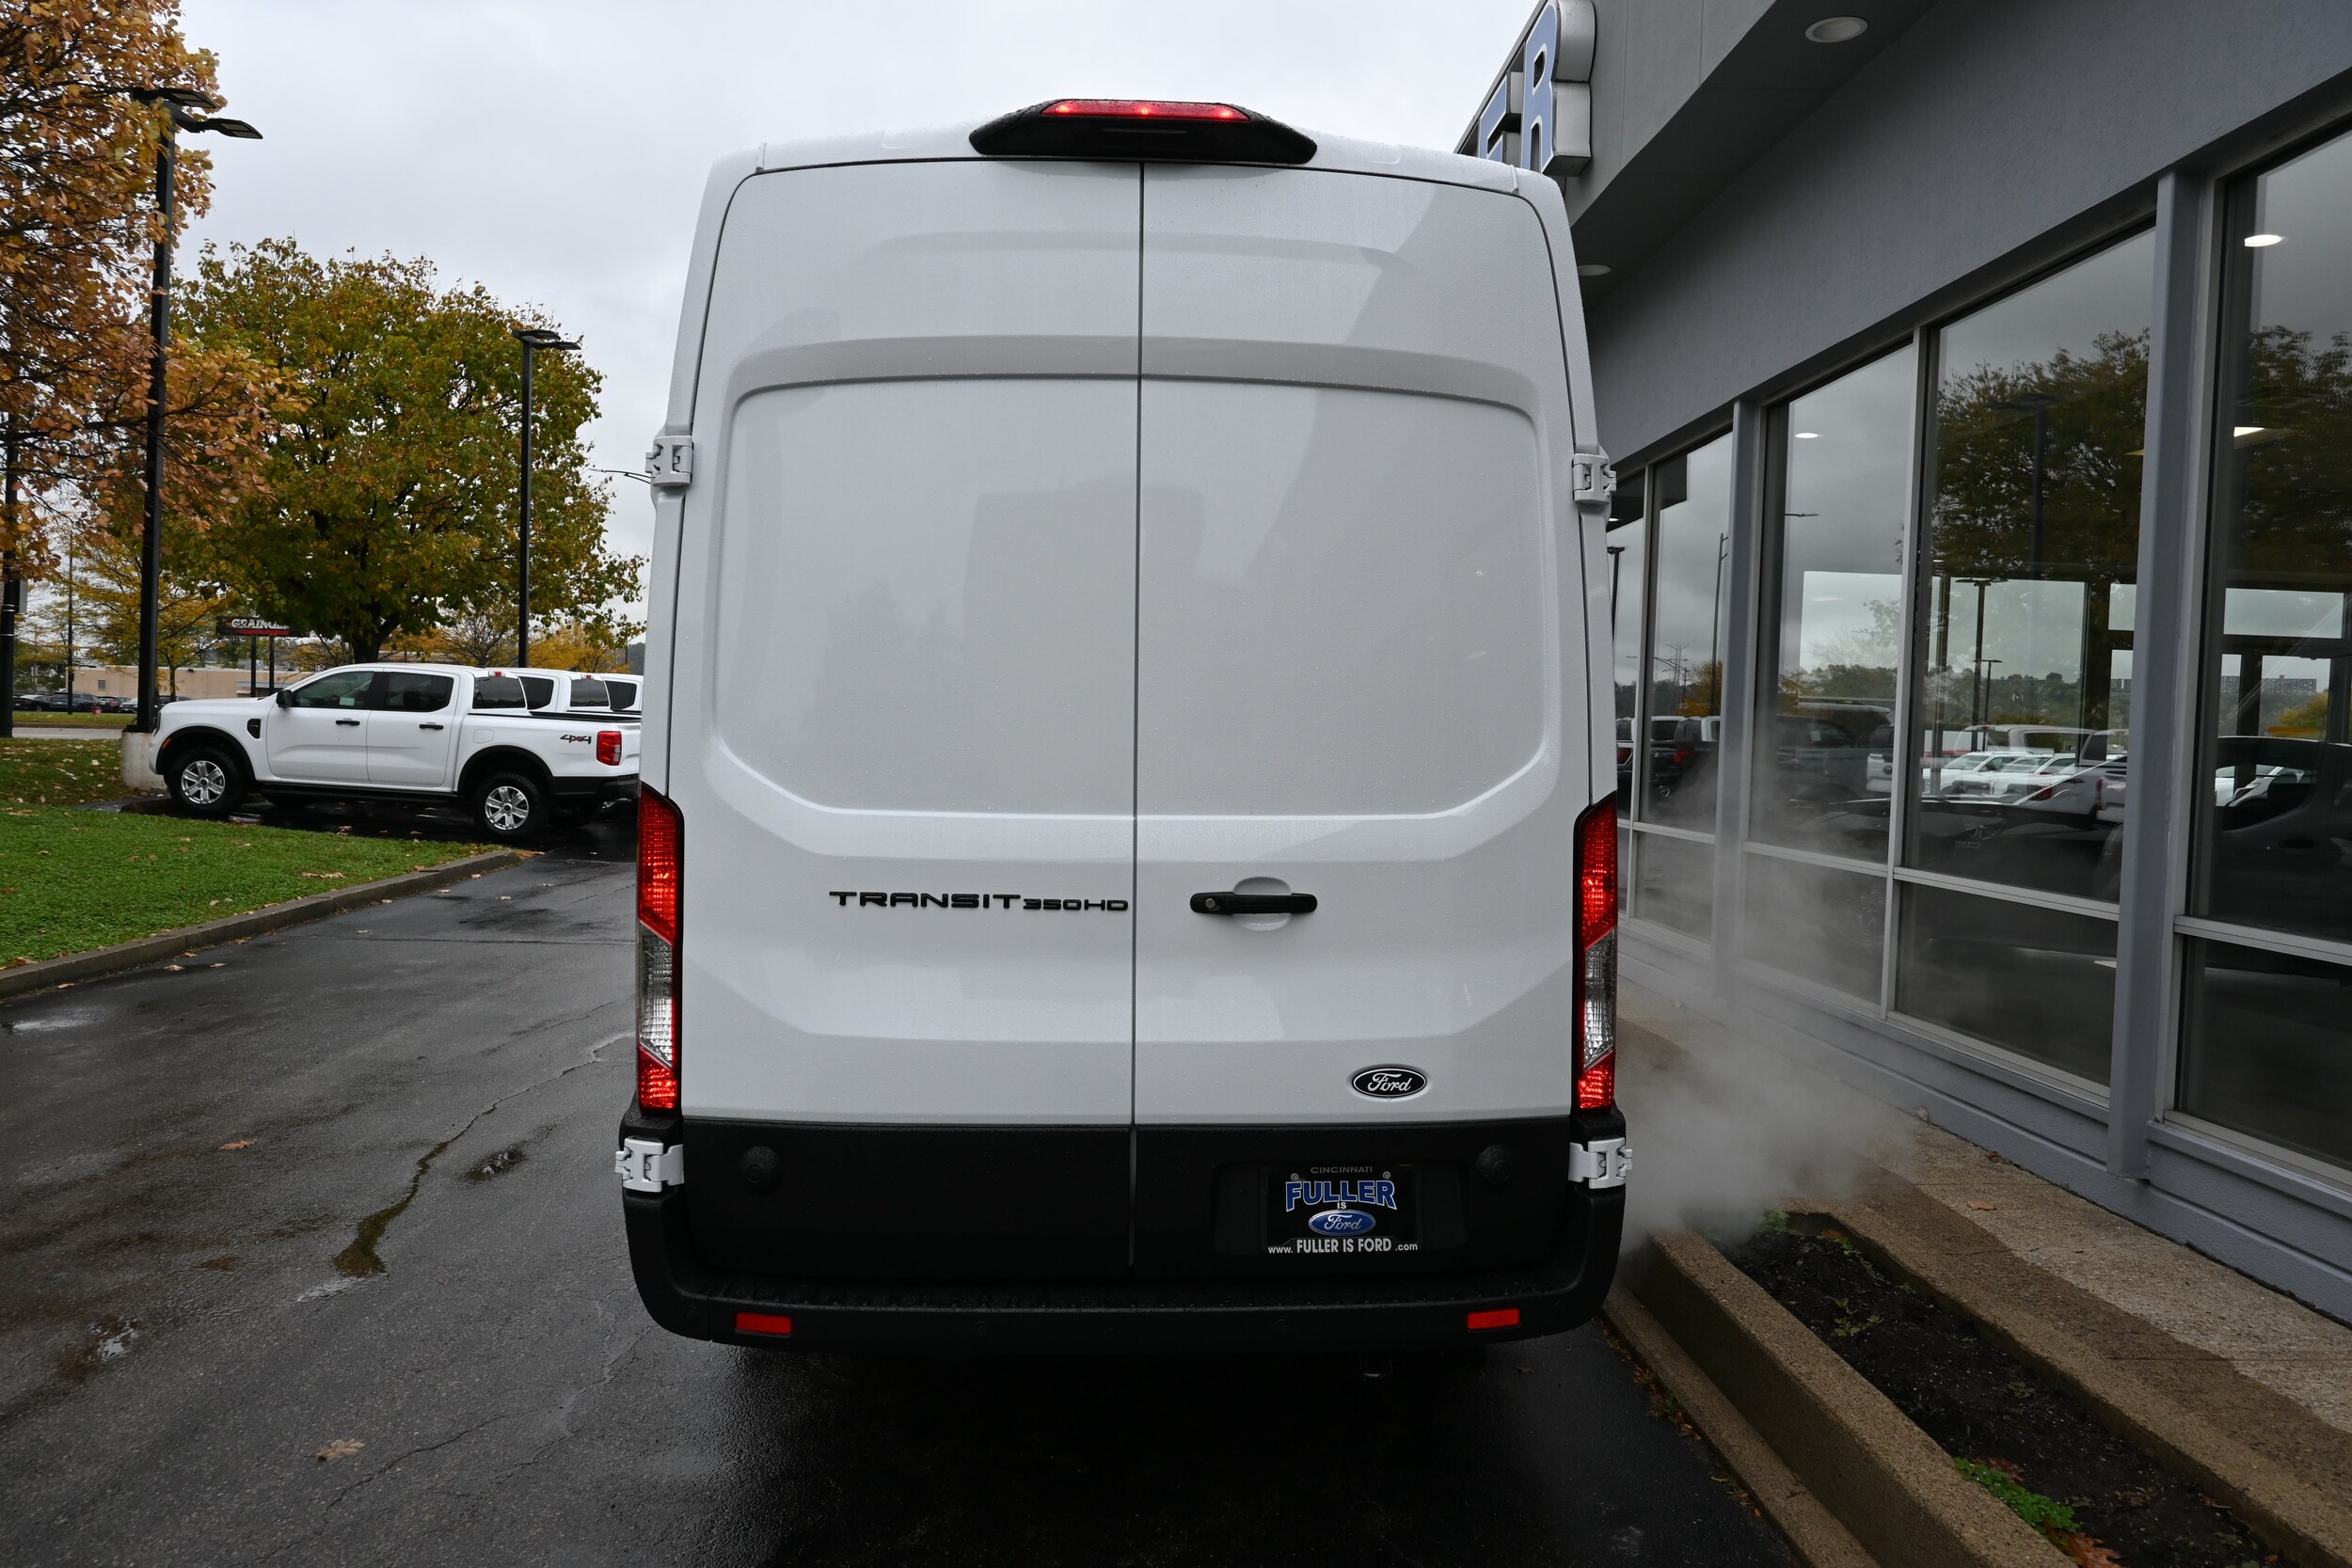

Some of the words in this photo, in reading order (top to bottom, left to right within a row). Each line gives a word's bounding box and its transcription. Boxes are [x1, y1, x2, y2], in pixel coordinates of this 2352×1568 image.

[829, 891, 1021, 909] TRANSIT
[1023, 898, 1128, 911] 350HD
[1367, 1072, 1412, 1092] Ford
[1311, 1165, 1373, 1174] CINCINNATI
[1285, 1180, 1397, 1212] FULLER
[1337, 1201, 1346, 1210] IS
[1324, 1213, 1362, 1230] Ford
[1296, 1239, 1339, 1253] FULLER
[1343, 1238, 1354, 1252] IS
[1358, 1238, 1391, 1252] FORD
